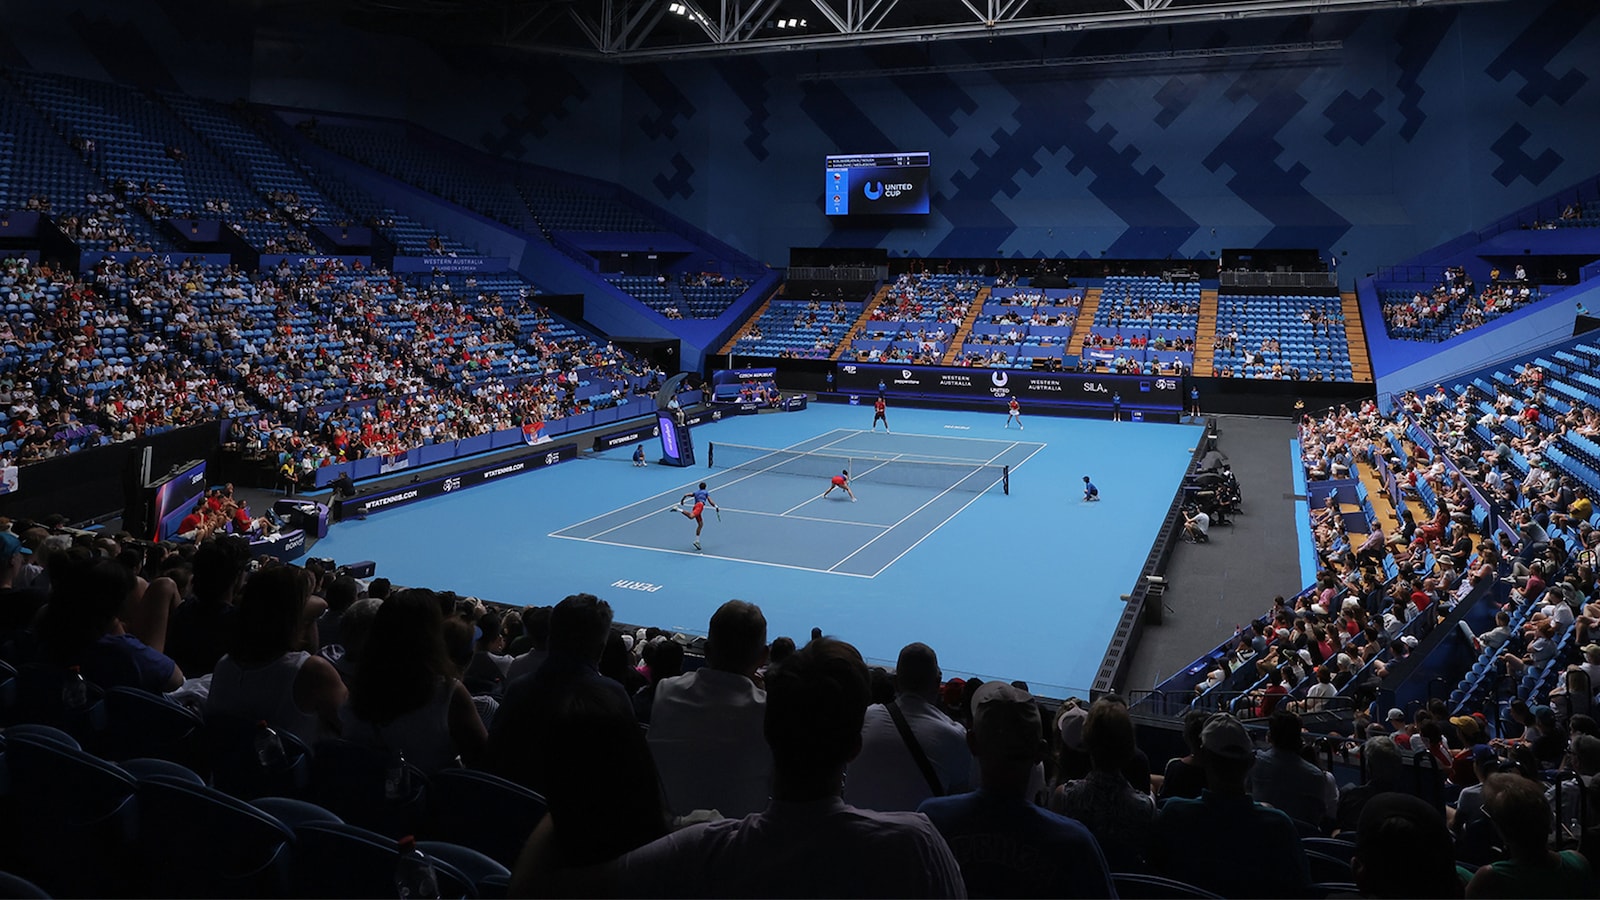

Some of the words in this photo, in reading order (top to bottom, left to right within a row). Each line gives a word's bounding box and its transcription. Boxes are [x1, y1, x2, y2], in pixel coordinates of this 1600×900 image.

[483, 462, 525, 479] WTATENNIS.COM
[365, 489, 418, 509] WTATENNIS.COM
[610, 579, 664, 593] PERTH
